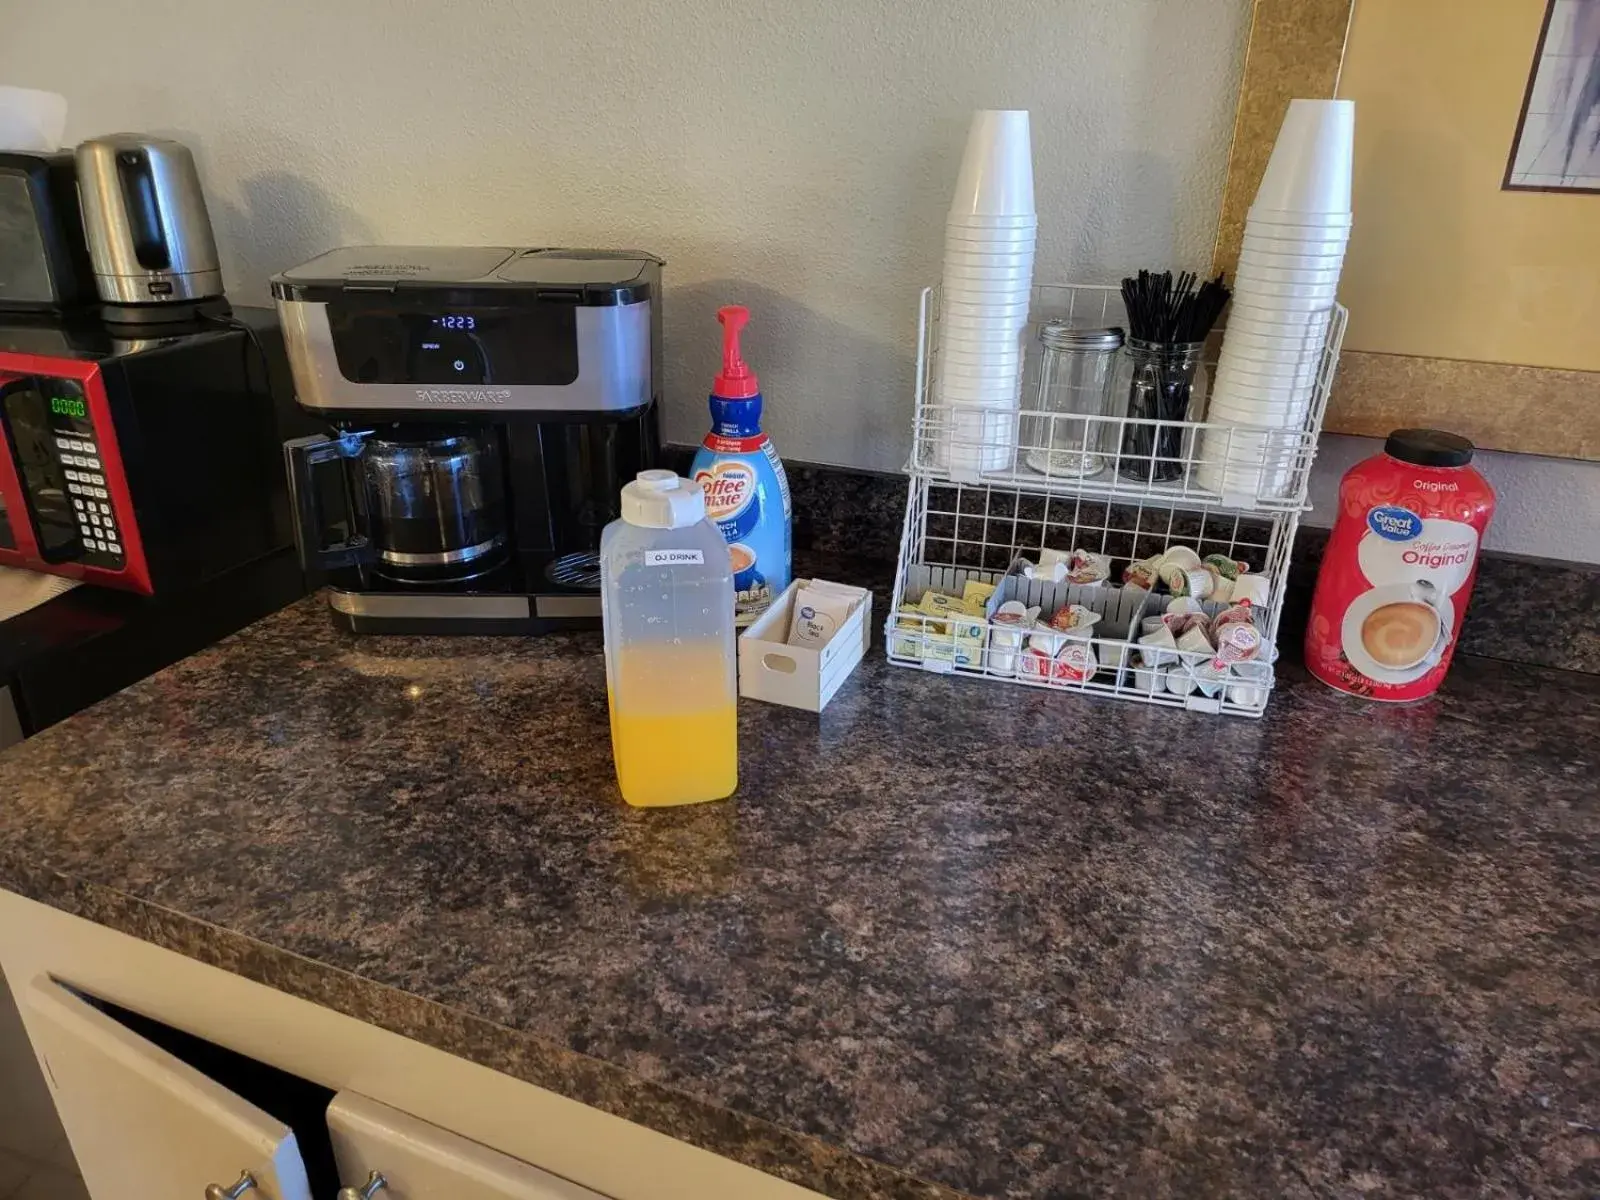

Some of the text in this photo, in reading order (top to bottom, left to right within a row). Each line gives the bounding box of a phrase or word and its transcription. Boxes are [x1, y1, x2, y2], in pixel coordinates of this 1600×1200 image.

[1413, 479, 1459, 493] Original
[1373, 510, 1414, 530] Great
[1381, 522, 1410, 536] Value
[654, 553, 698, 562] OJ DRINK
[1402, 549, 1469, 569] Original
